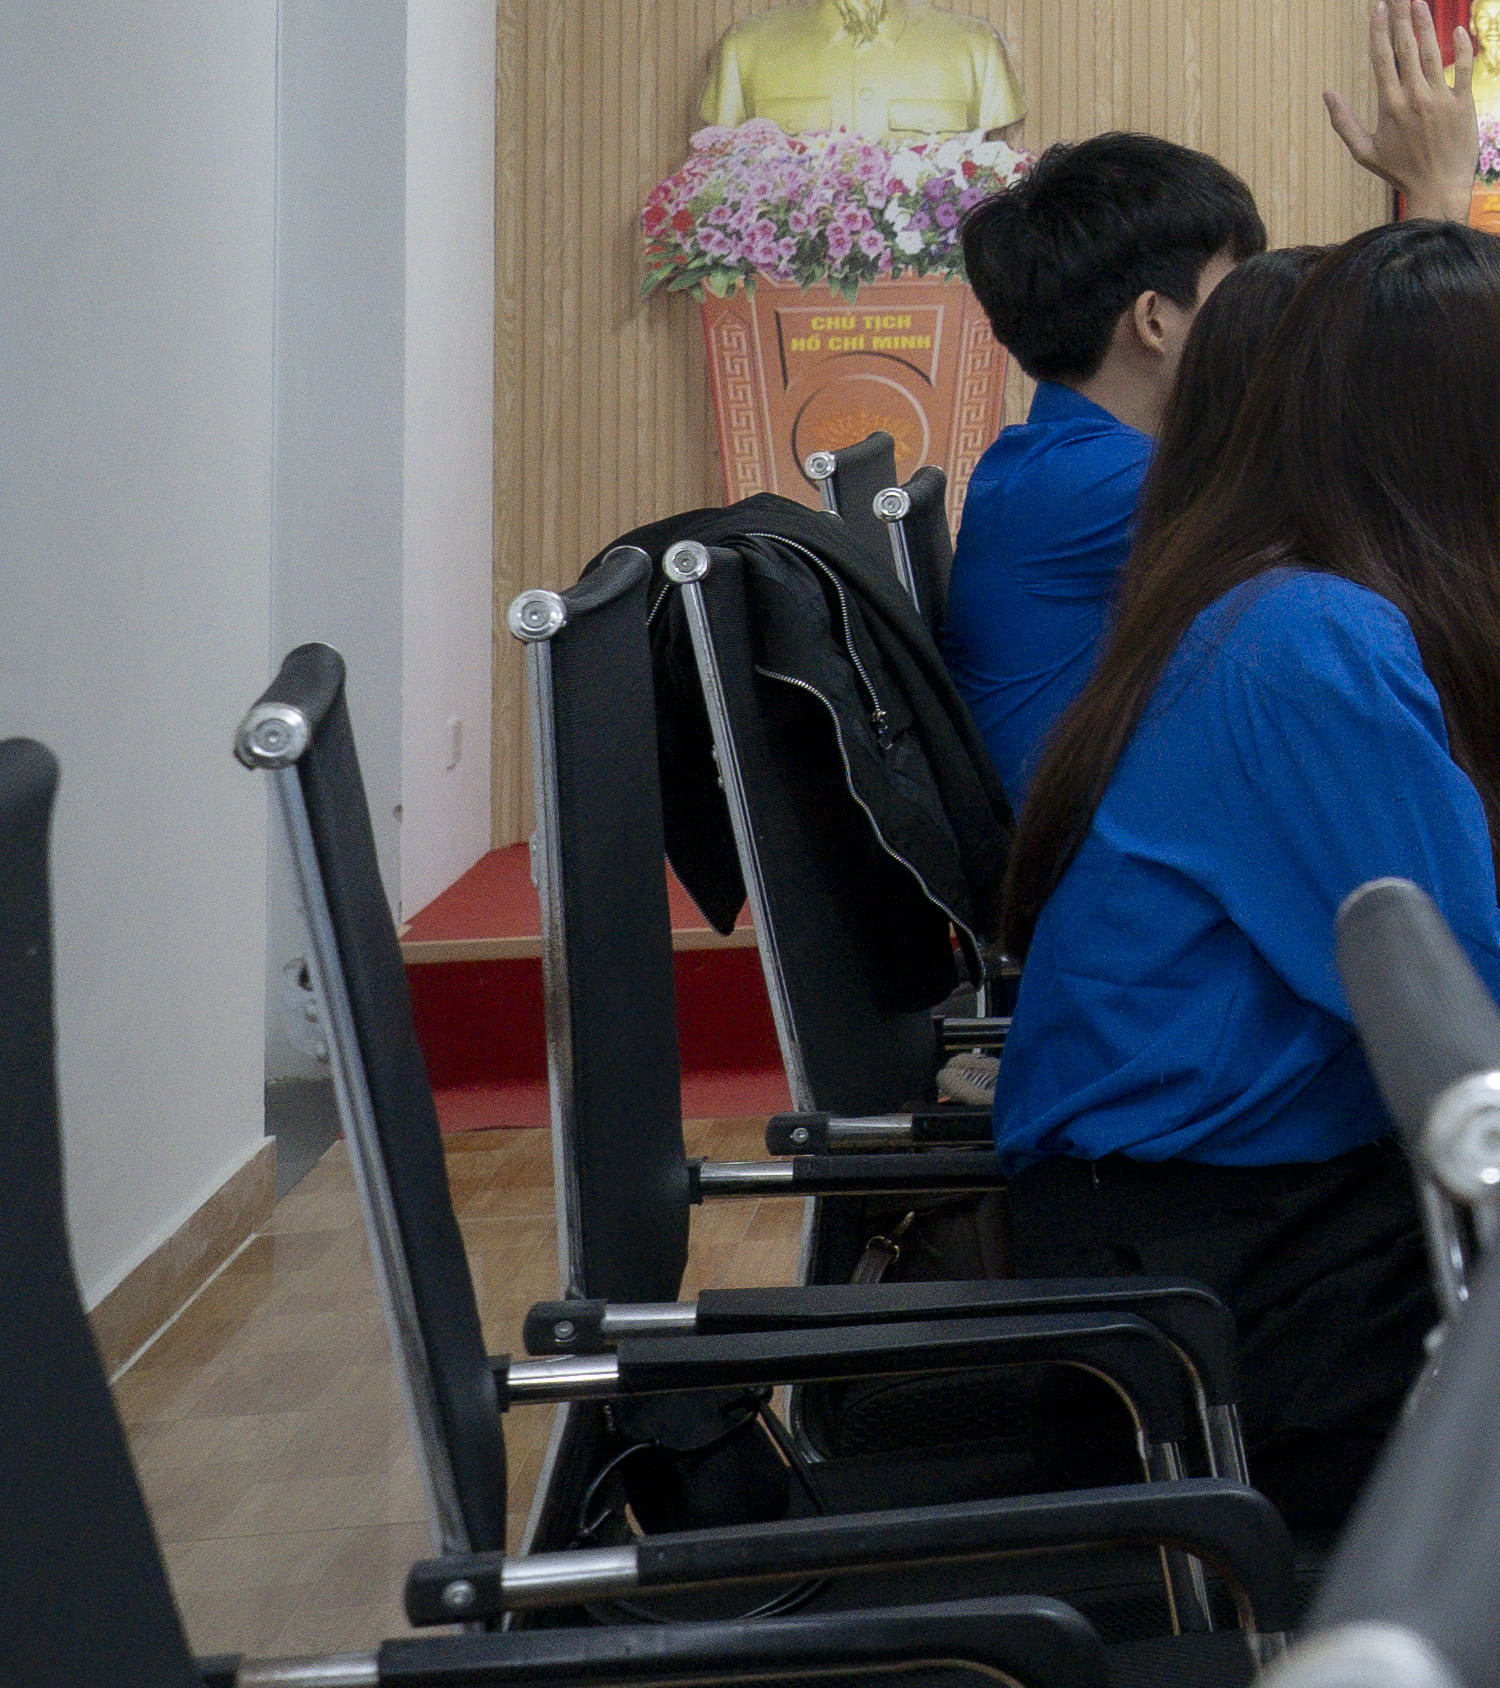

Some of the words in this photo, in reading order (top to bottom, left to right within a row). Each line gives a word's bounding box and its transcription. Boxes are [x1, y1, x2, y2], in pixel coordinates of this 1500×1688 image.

[811, 310, 855, 330] CHỦ
[862, 314, 912, 332] TỊCH
[872, 335, 931, 350] MINH
